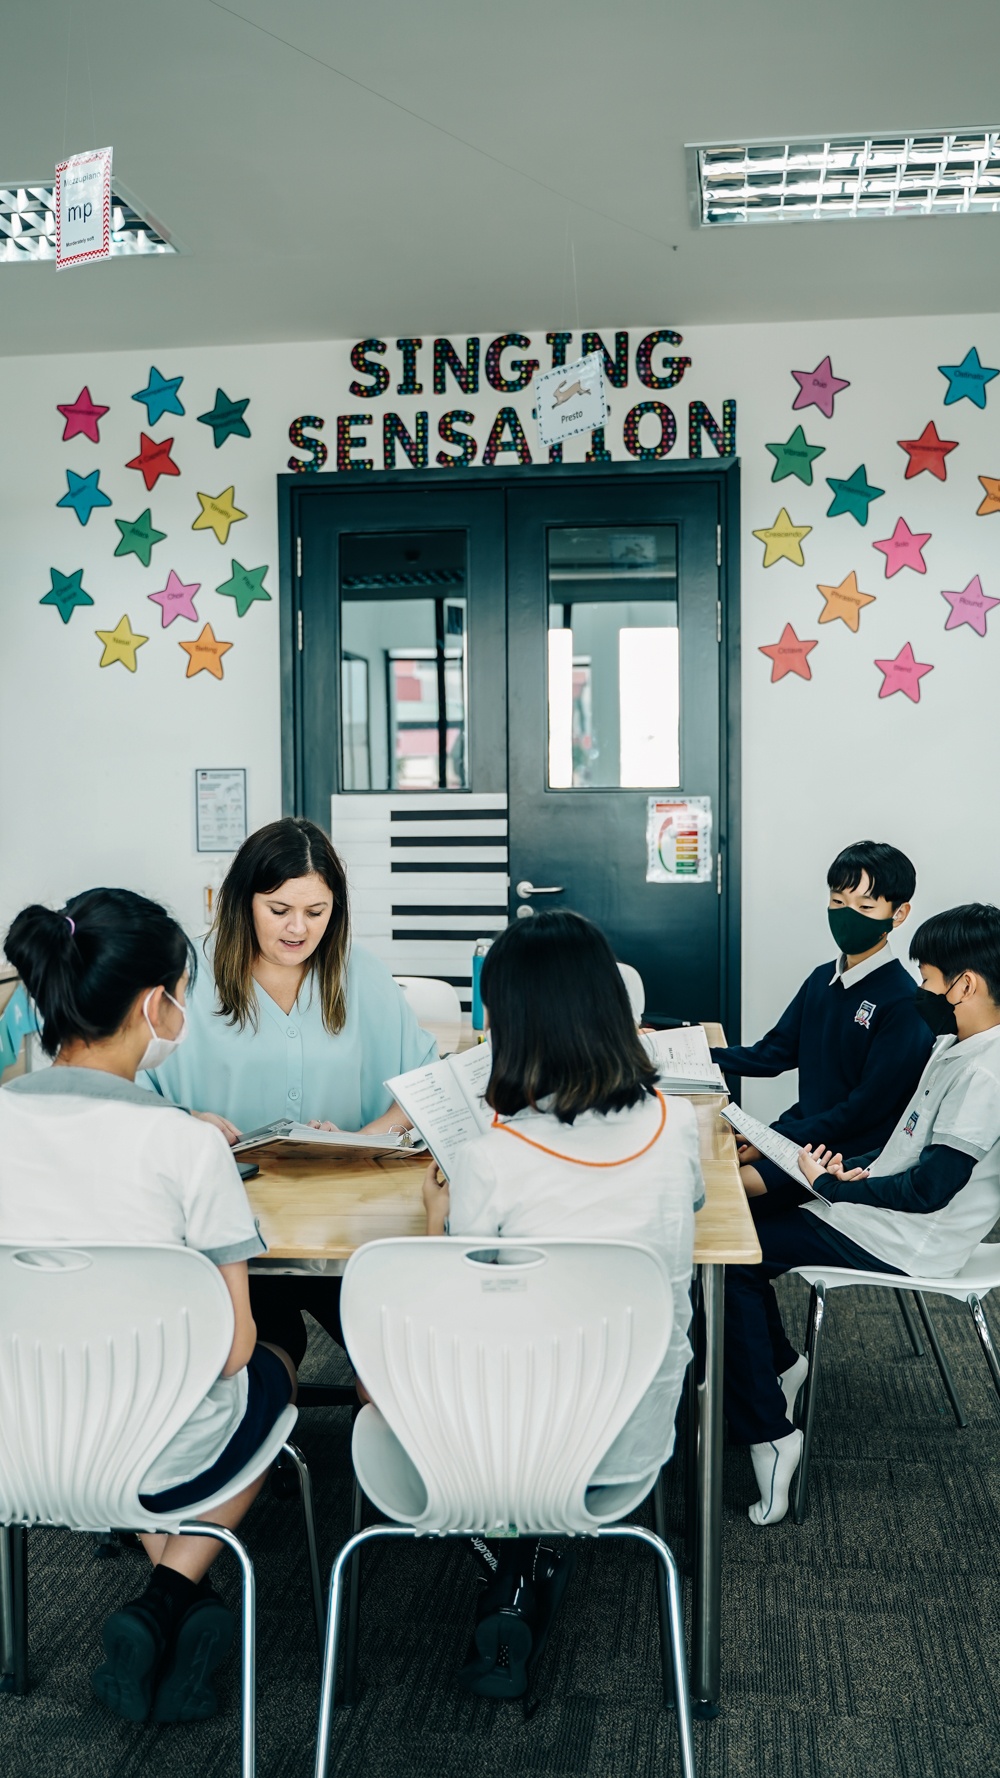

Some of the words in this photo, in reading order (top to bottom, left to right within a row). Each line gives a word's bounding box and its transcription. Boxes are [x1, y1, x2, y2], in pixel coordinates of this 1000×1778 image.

[68, 202, 93, 223] mp
[561, 410, 584, 424] Presto
[287, 399, 737, 473] SENSAION
[763, 530, 802, 538] Crescendo
[894, 540, 909, 548] Solo
[830, 590, 862, 606] Phrasing
[958, 597, 983, 608] Round
